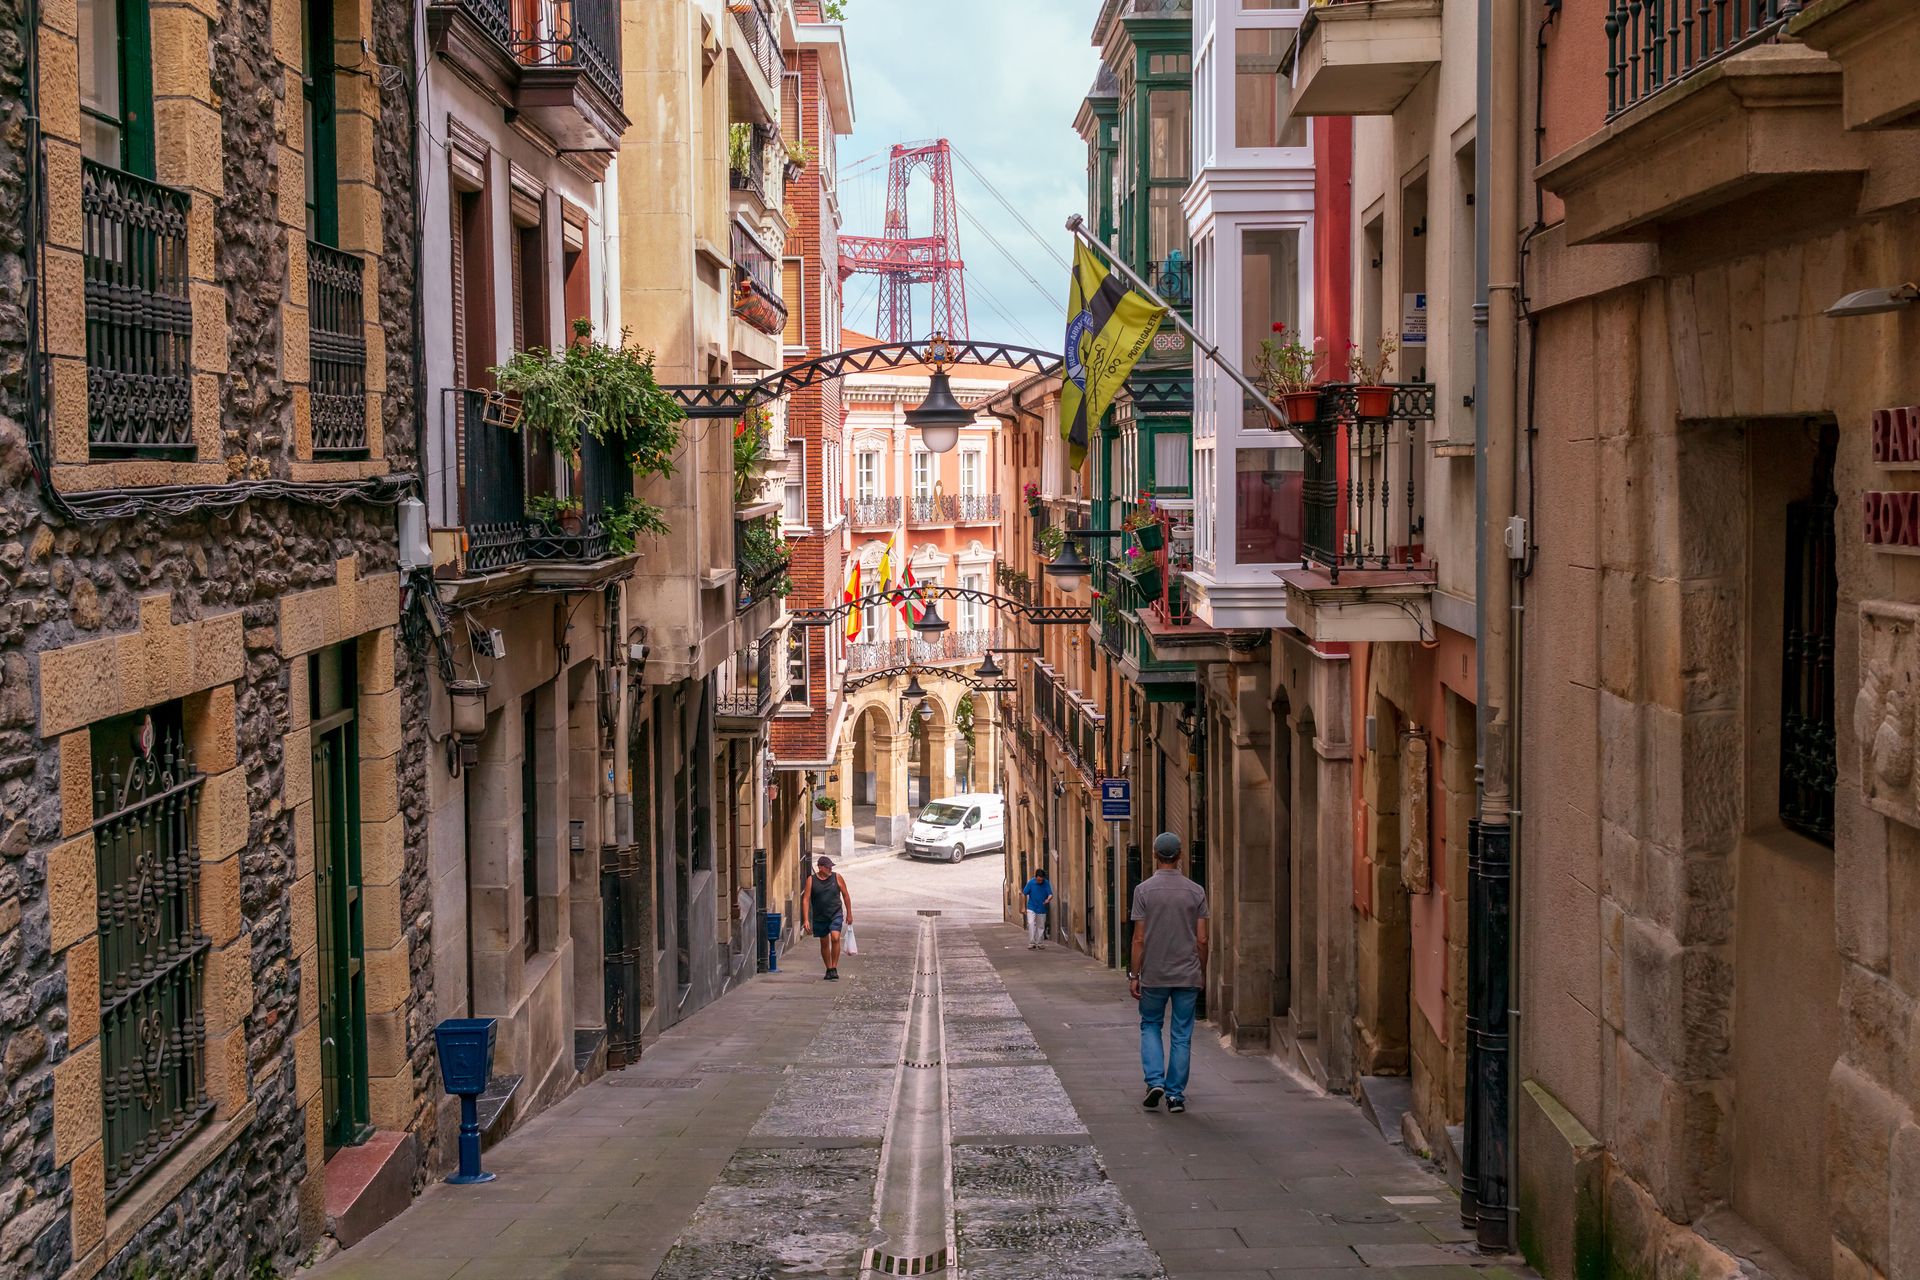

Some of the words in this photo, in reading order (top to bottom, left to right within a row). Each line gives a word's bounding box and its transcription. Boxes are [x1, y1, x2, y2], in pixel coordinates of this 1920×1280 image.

[1067, 346, 1077, 367] REMO
[1127, 313, 1159, 361] PORTUGALETE
[1863, 492, 1920, 545] BOX
